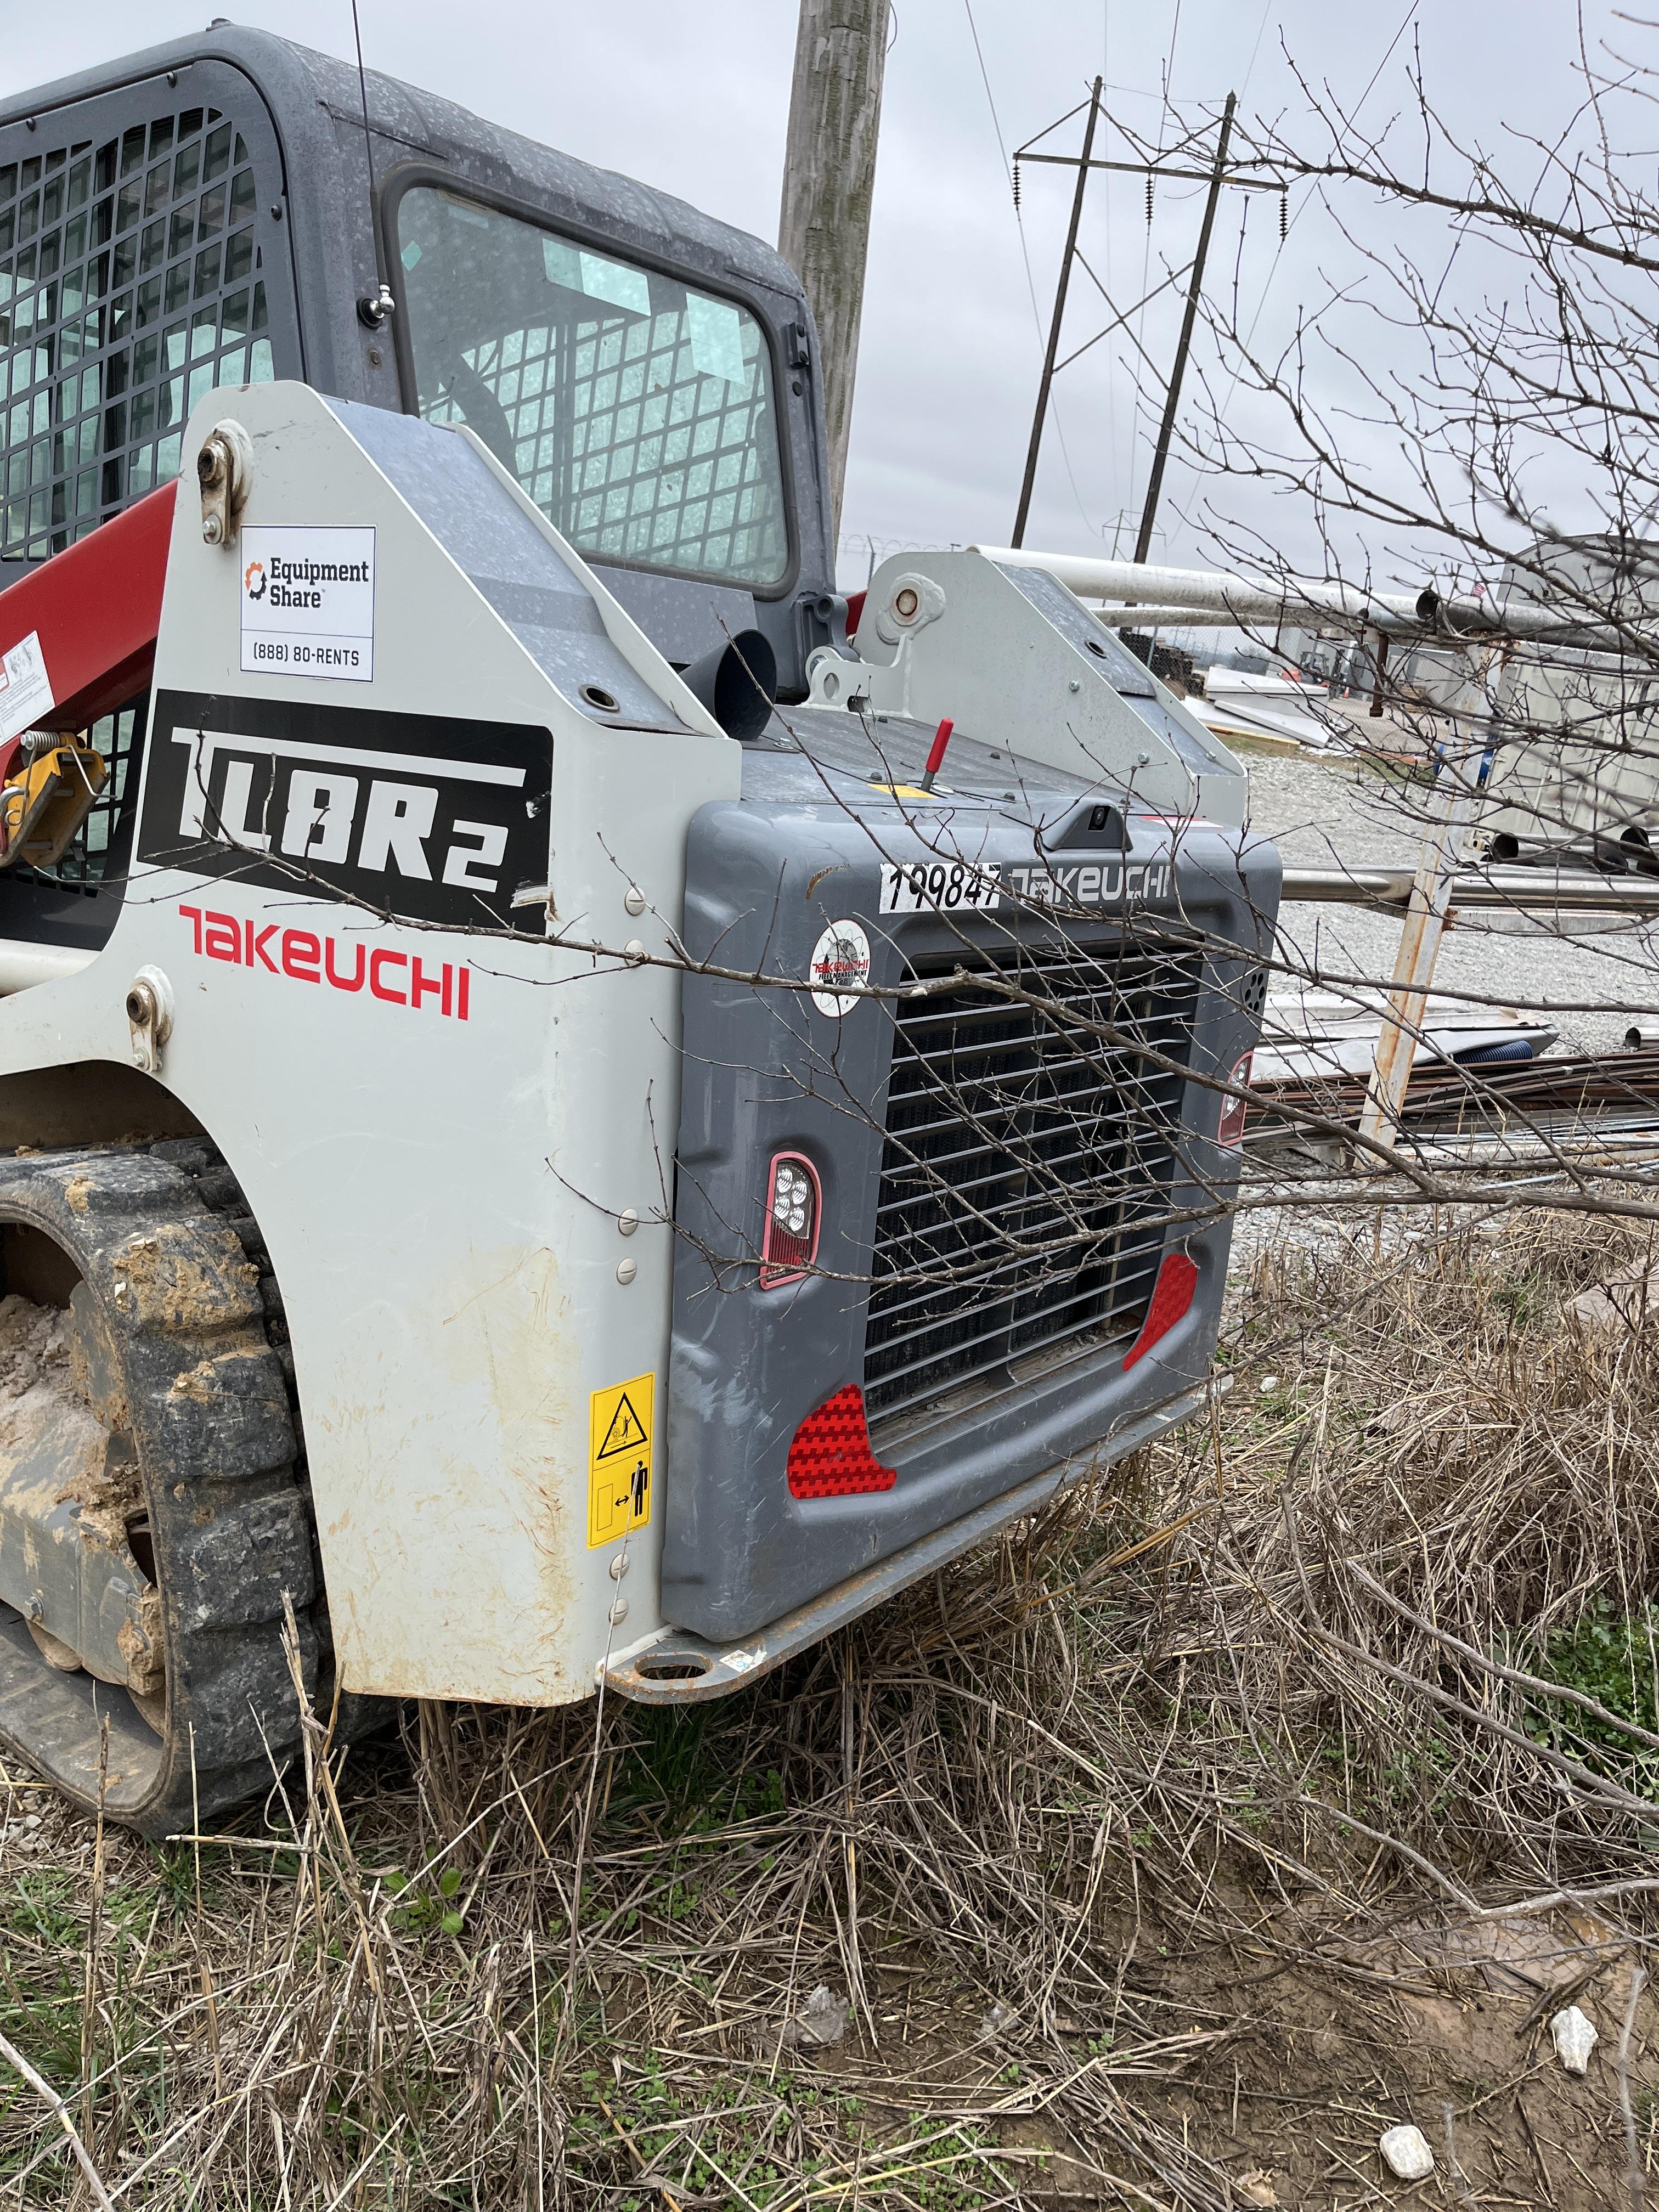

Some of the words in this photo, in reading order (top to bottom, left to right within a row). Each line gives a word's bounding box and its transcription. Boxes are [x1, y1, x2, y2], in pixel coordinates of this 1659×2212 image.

[270, 557, 369, 585] Equipment
[270, 585, 321, 608] Share
[253, 642, 288, 662] (888)
[294, 646, 359, 666] 80-RENTS
[171, 727, 526, 893] TL8R2
[890, 864, 1002, 910] 199847
[1012, 866, 1171, 905] TAKEUCHI
[179, 904, 470, 1020] TAKEUCHI
